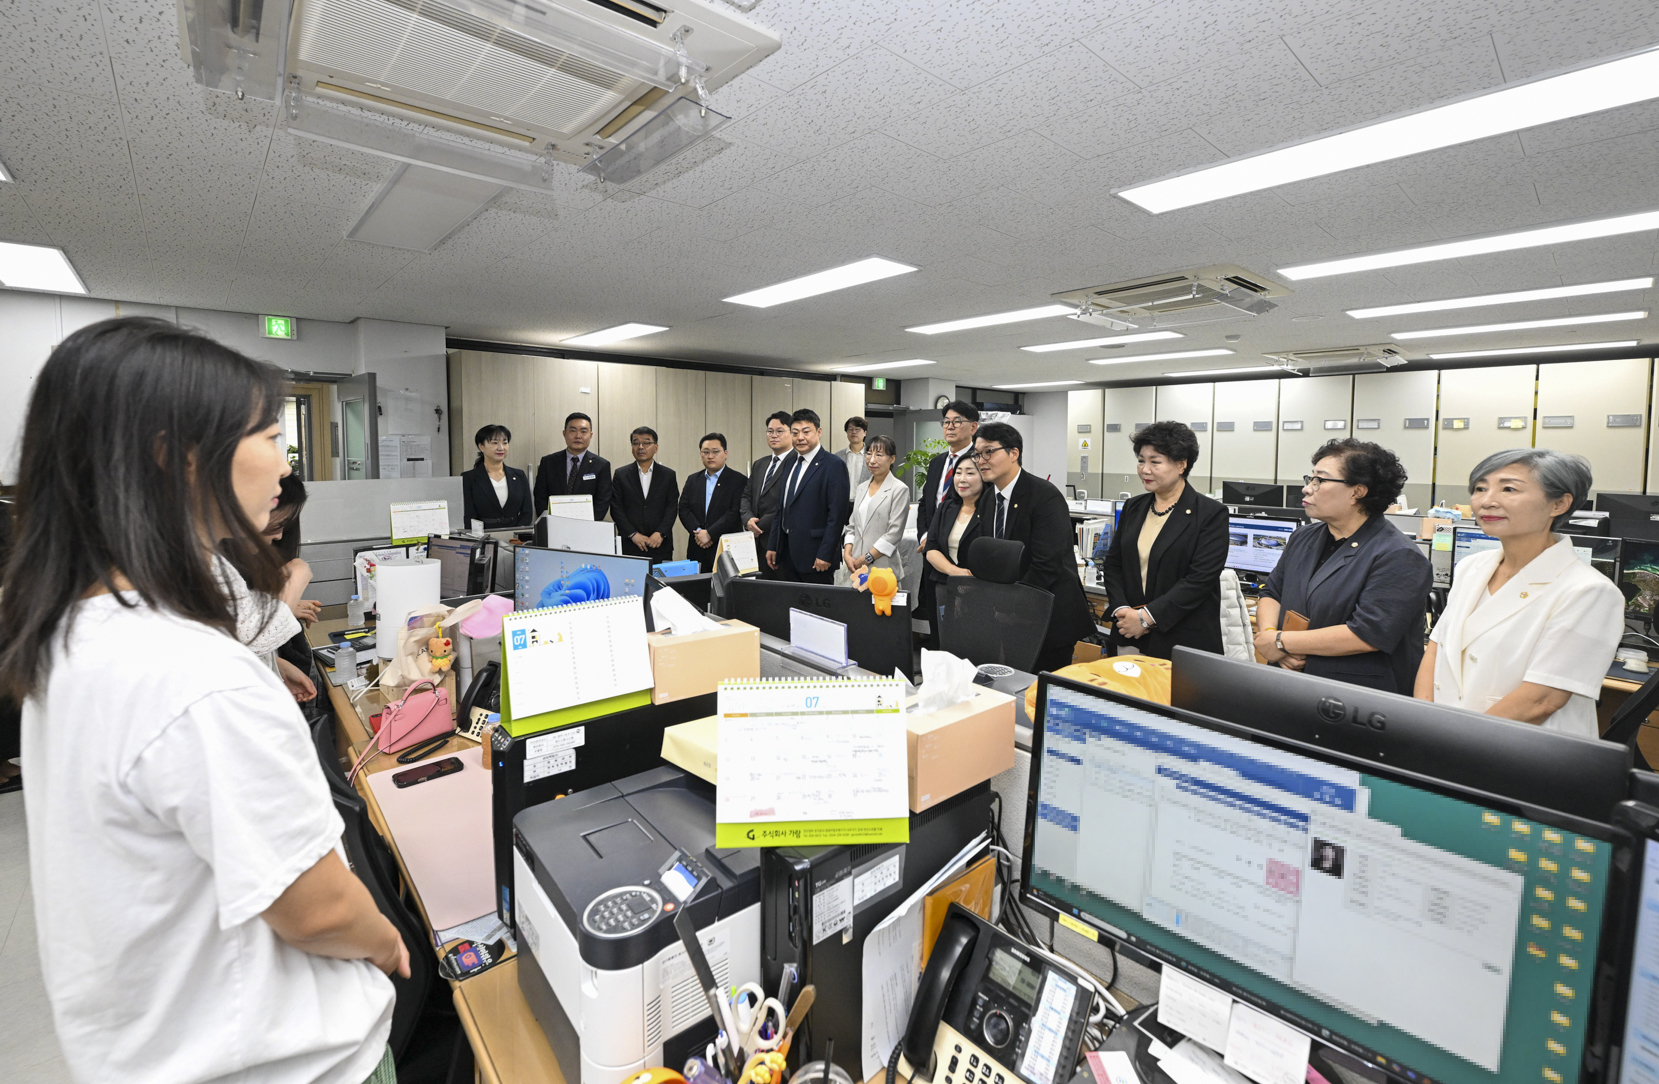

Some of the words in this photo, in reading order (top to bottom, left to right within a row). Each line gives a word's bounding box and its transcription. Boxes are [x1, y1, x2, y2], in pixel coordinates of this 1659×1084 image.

[816, 598, 831, 608] LG
[513, 634, 526, 646] 07
[805, 696, 820, 709] 07
[1351, 706, 1387, 732] LG
[762, 829, 787, 839] 주식회사
[788, 829, 802, 839] 가람
